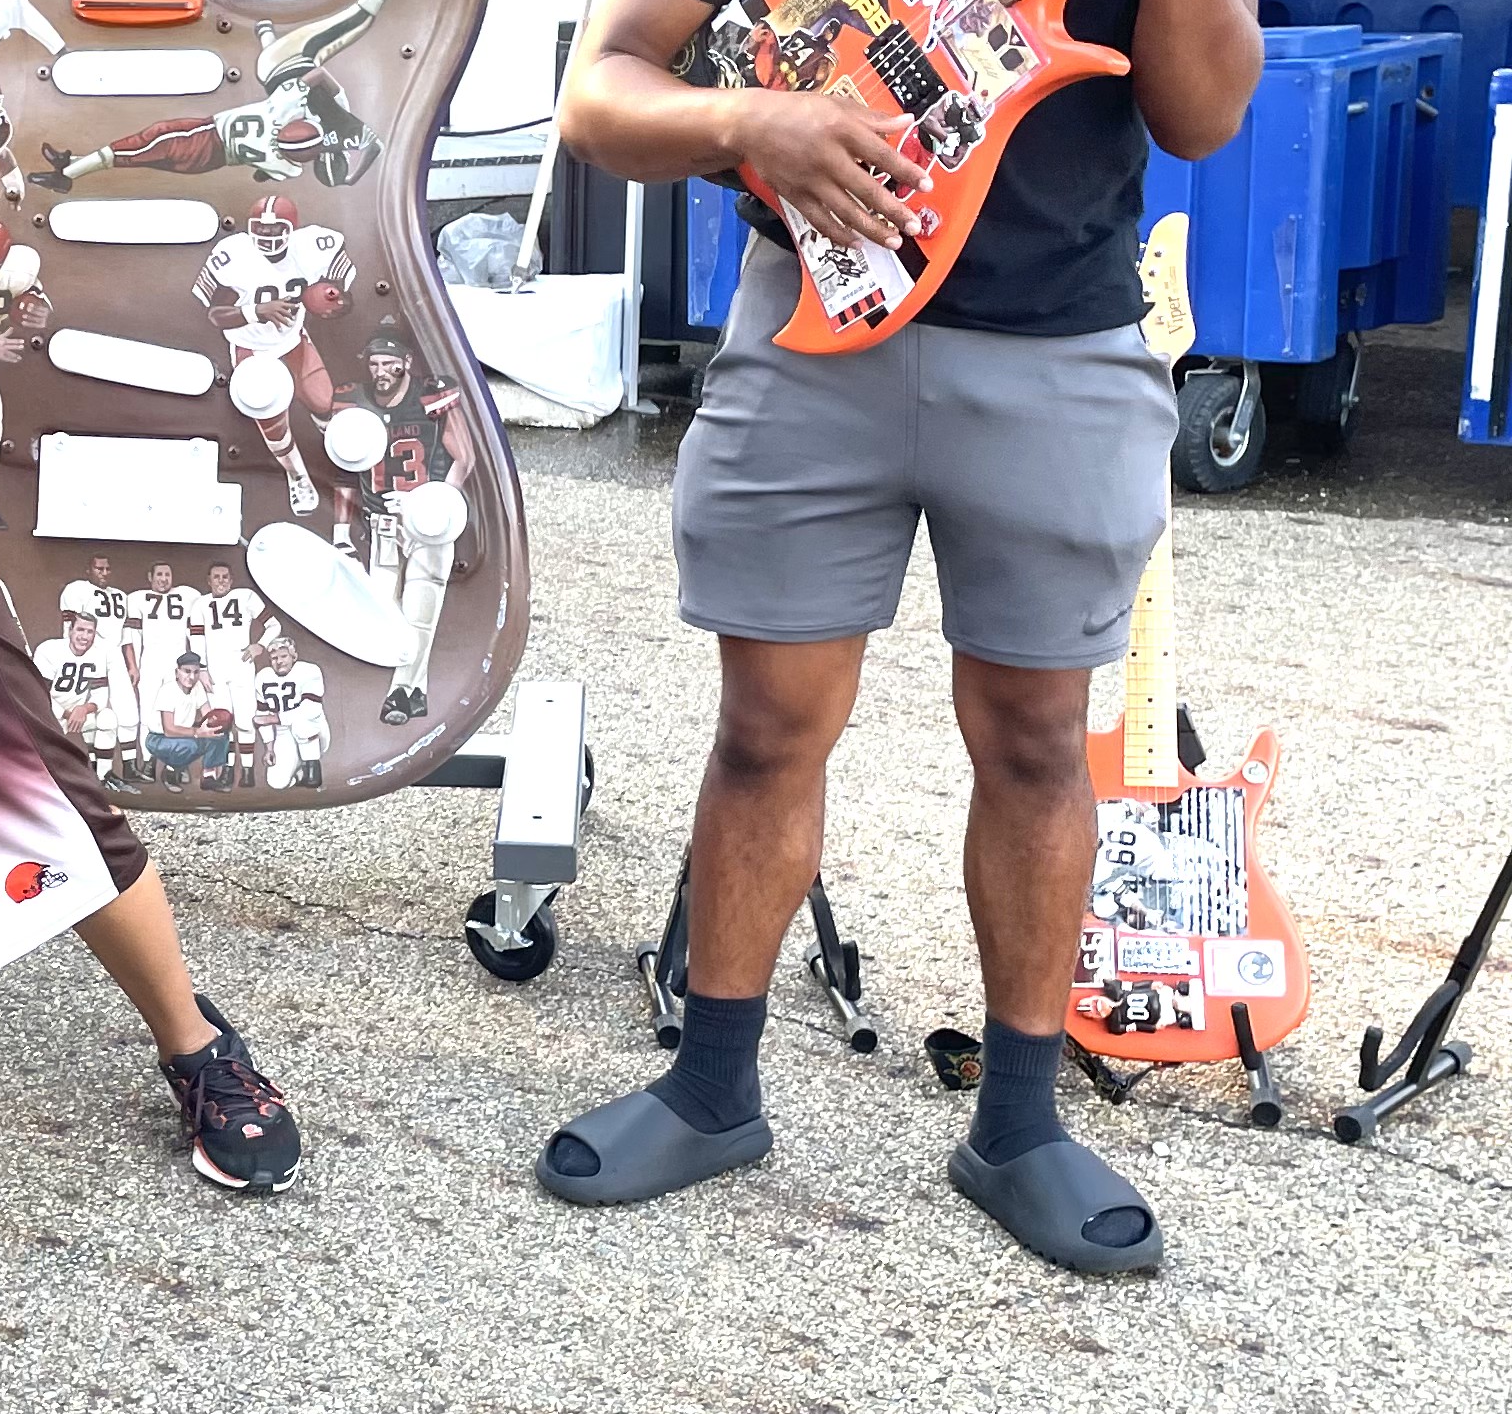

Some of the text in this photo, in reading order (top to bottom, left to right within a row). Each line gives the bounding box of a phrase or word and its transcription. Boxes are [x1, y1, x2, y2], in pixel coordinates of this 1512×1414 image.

[230, 114, 266, 163] 64
[1168, 296, 1187, 335] Viper
[390, 425, 420, 437] LAND
[371, 437, 429, 494] 13
[93, 589, 126, 619] 36
[145, 592, 184, 620] 76
[208, 598, 243, 630] 14
[54, 661, 96, 695] 86
[261, 681, 301, 713] 52
[1126, 993, 1150, 1021] 00
